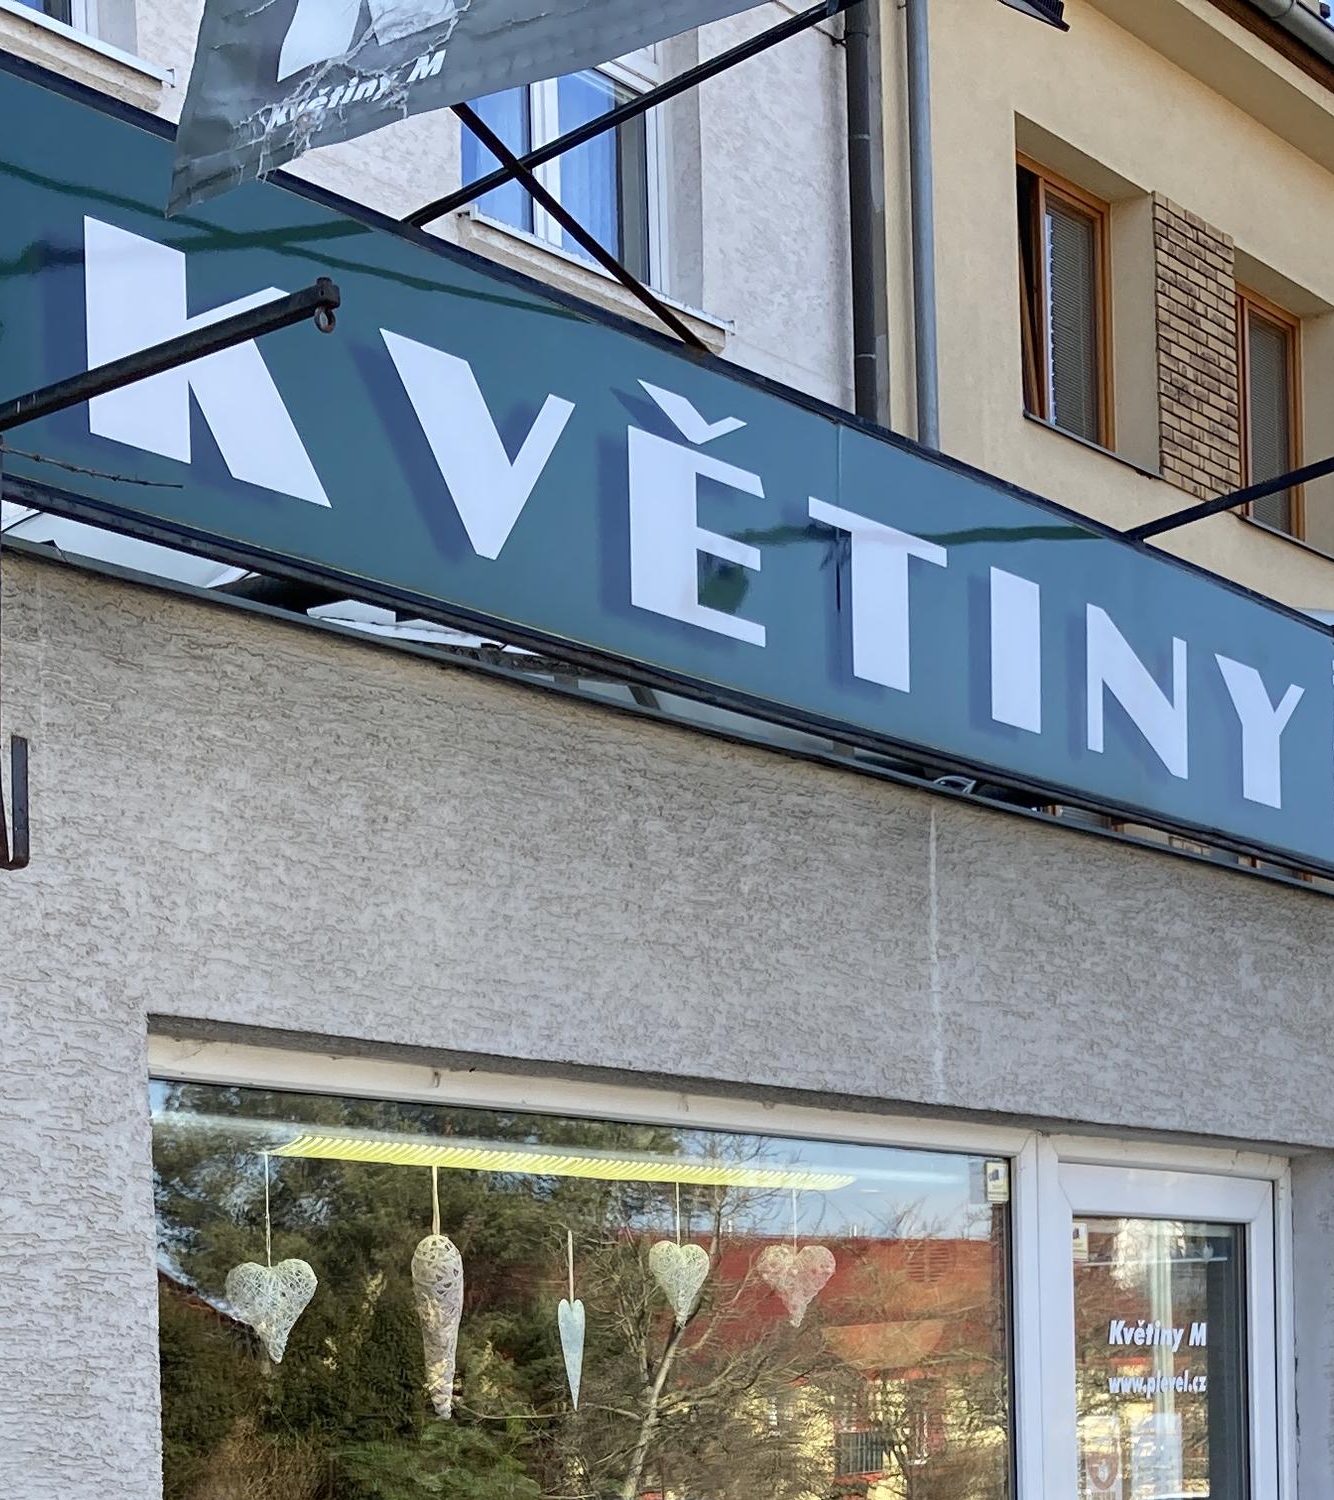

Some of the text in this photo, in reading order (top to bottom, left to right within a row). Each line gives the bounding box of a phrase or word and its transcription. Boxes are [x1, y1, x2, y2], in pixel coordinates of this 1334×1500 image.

[83, 214, 1305, 810] KVĚTINY
[1108, 1319, 1207, 1353] Květiny M
[1108, 1369, 1207, 1399] www.plevel.cz
